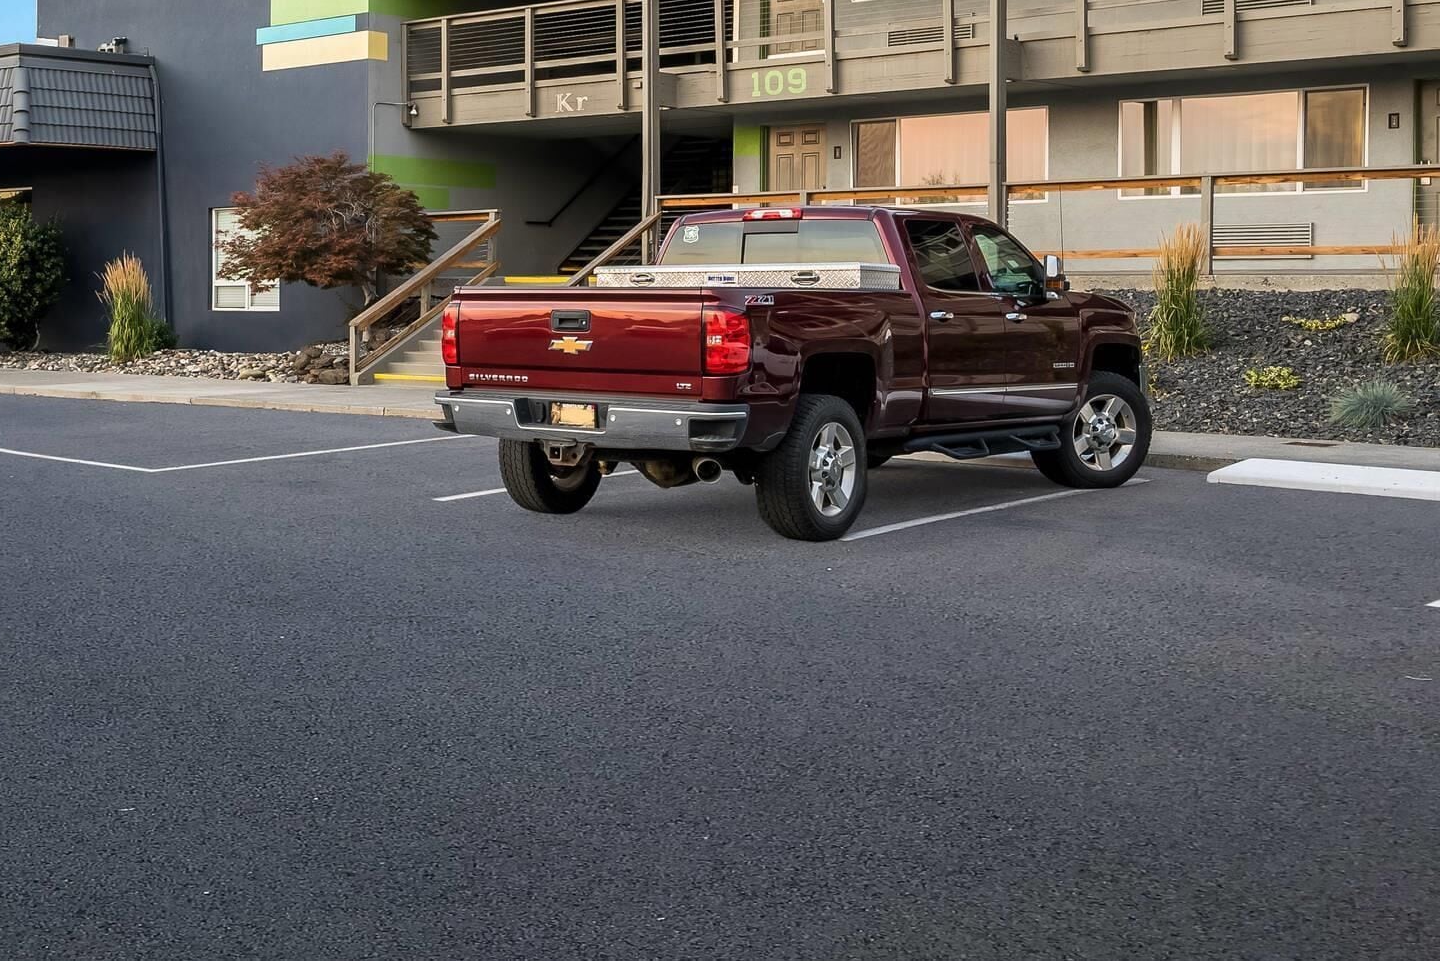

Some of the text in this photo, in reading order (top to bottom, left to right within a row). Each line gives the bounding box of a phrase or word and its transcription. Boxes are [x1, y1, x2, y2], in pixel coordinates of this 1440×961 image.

[751, 67, 807, 97] 109
[554, 92, 589, 113] Kr
[468, 373, 529, 383] SILVERADO
